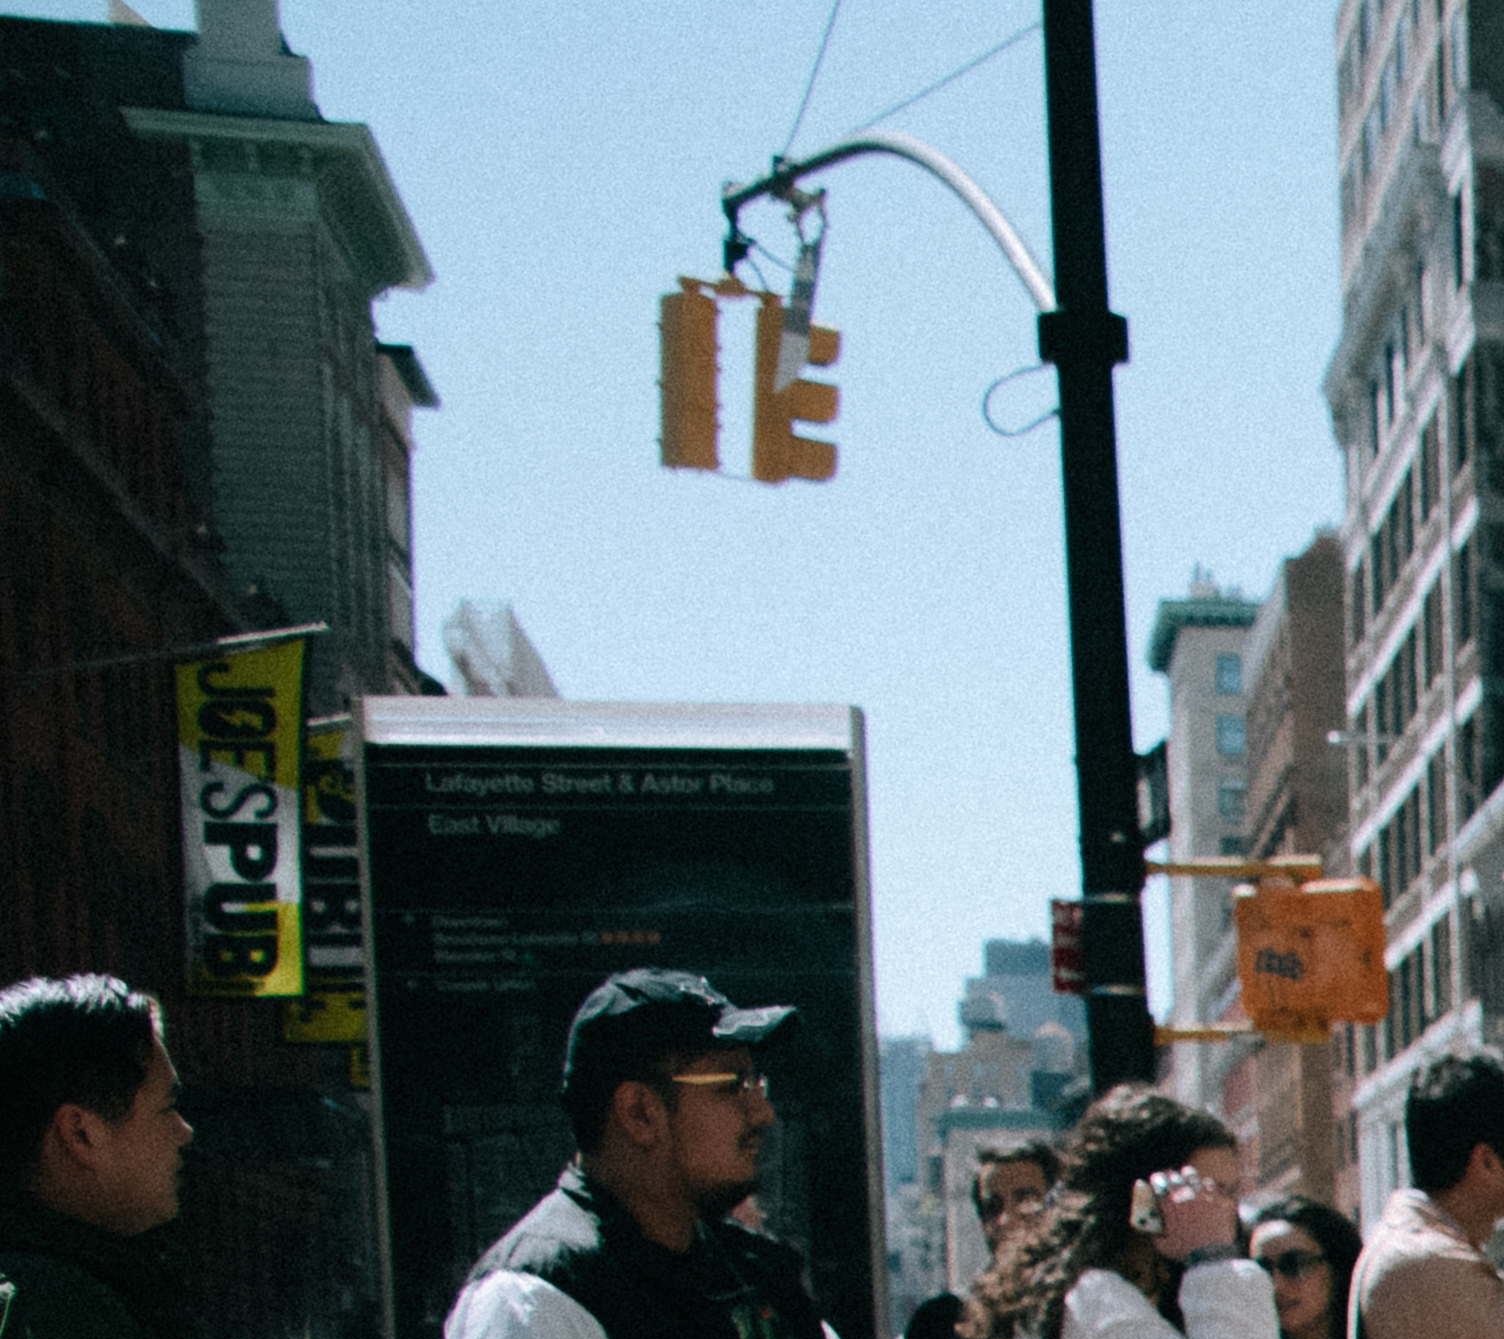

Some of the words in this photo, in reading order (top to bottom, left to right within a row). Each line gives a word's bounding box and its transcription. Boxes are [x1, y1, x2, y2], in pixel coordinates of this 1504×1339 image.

[425, 772, 534, 797] Lafayette
[541, 774, 612, 794] Street
[641, 774, 700, 794] Astor
[709, 774, 775, 794] Place
[427, 814, 480, 834] East
[485, 814, 561, 838] Village
